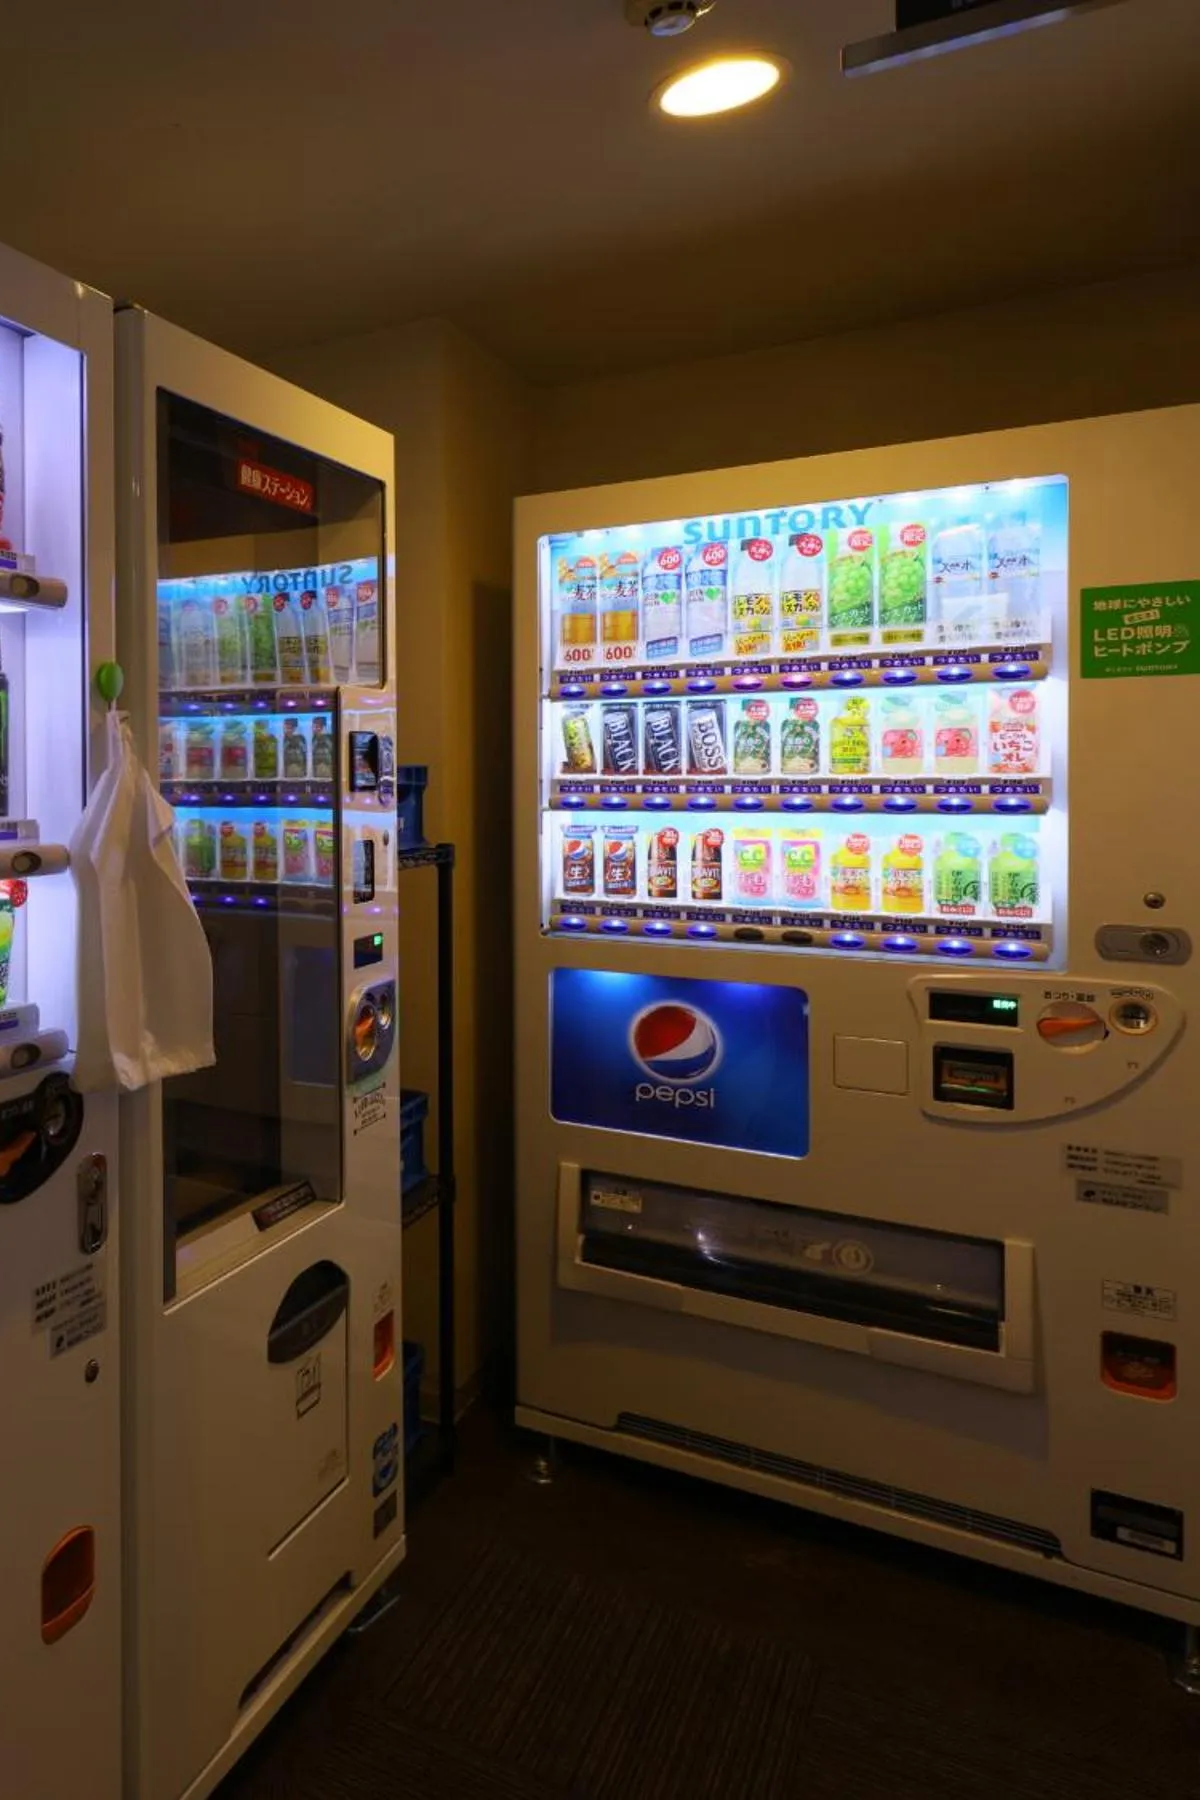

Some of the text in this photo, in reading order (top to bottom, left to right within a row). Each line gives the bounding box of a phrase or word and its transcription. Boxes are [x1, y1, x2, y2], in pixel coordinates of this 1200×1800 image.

[684, 501, 874, 545] SUNTORY
[658, 554, 680, 566] 600
[704, 549, 725, 562] 600
[1094, 624, 1173, 643] LED照明
[565, 649, 591, 662] 600
[606, 647, 633, 660] 600
[1094, 640, 1191, 658] ヒートポンプ
[605, 713, 633, 771] BLACK
[649, 713, 675, 771] BLACK
[697, 719, 724, 770] BOSS
[635, 1082, 715, 1109] pepsi
